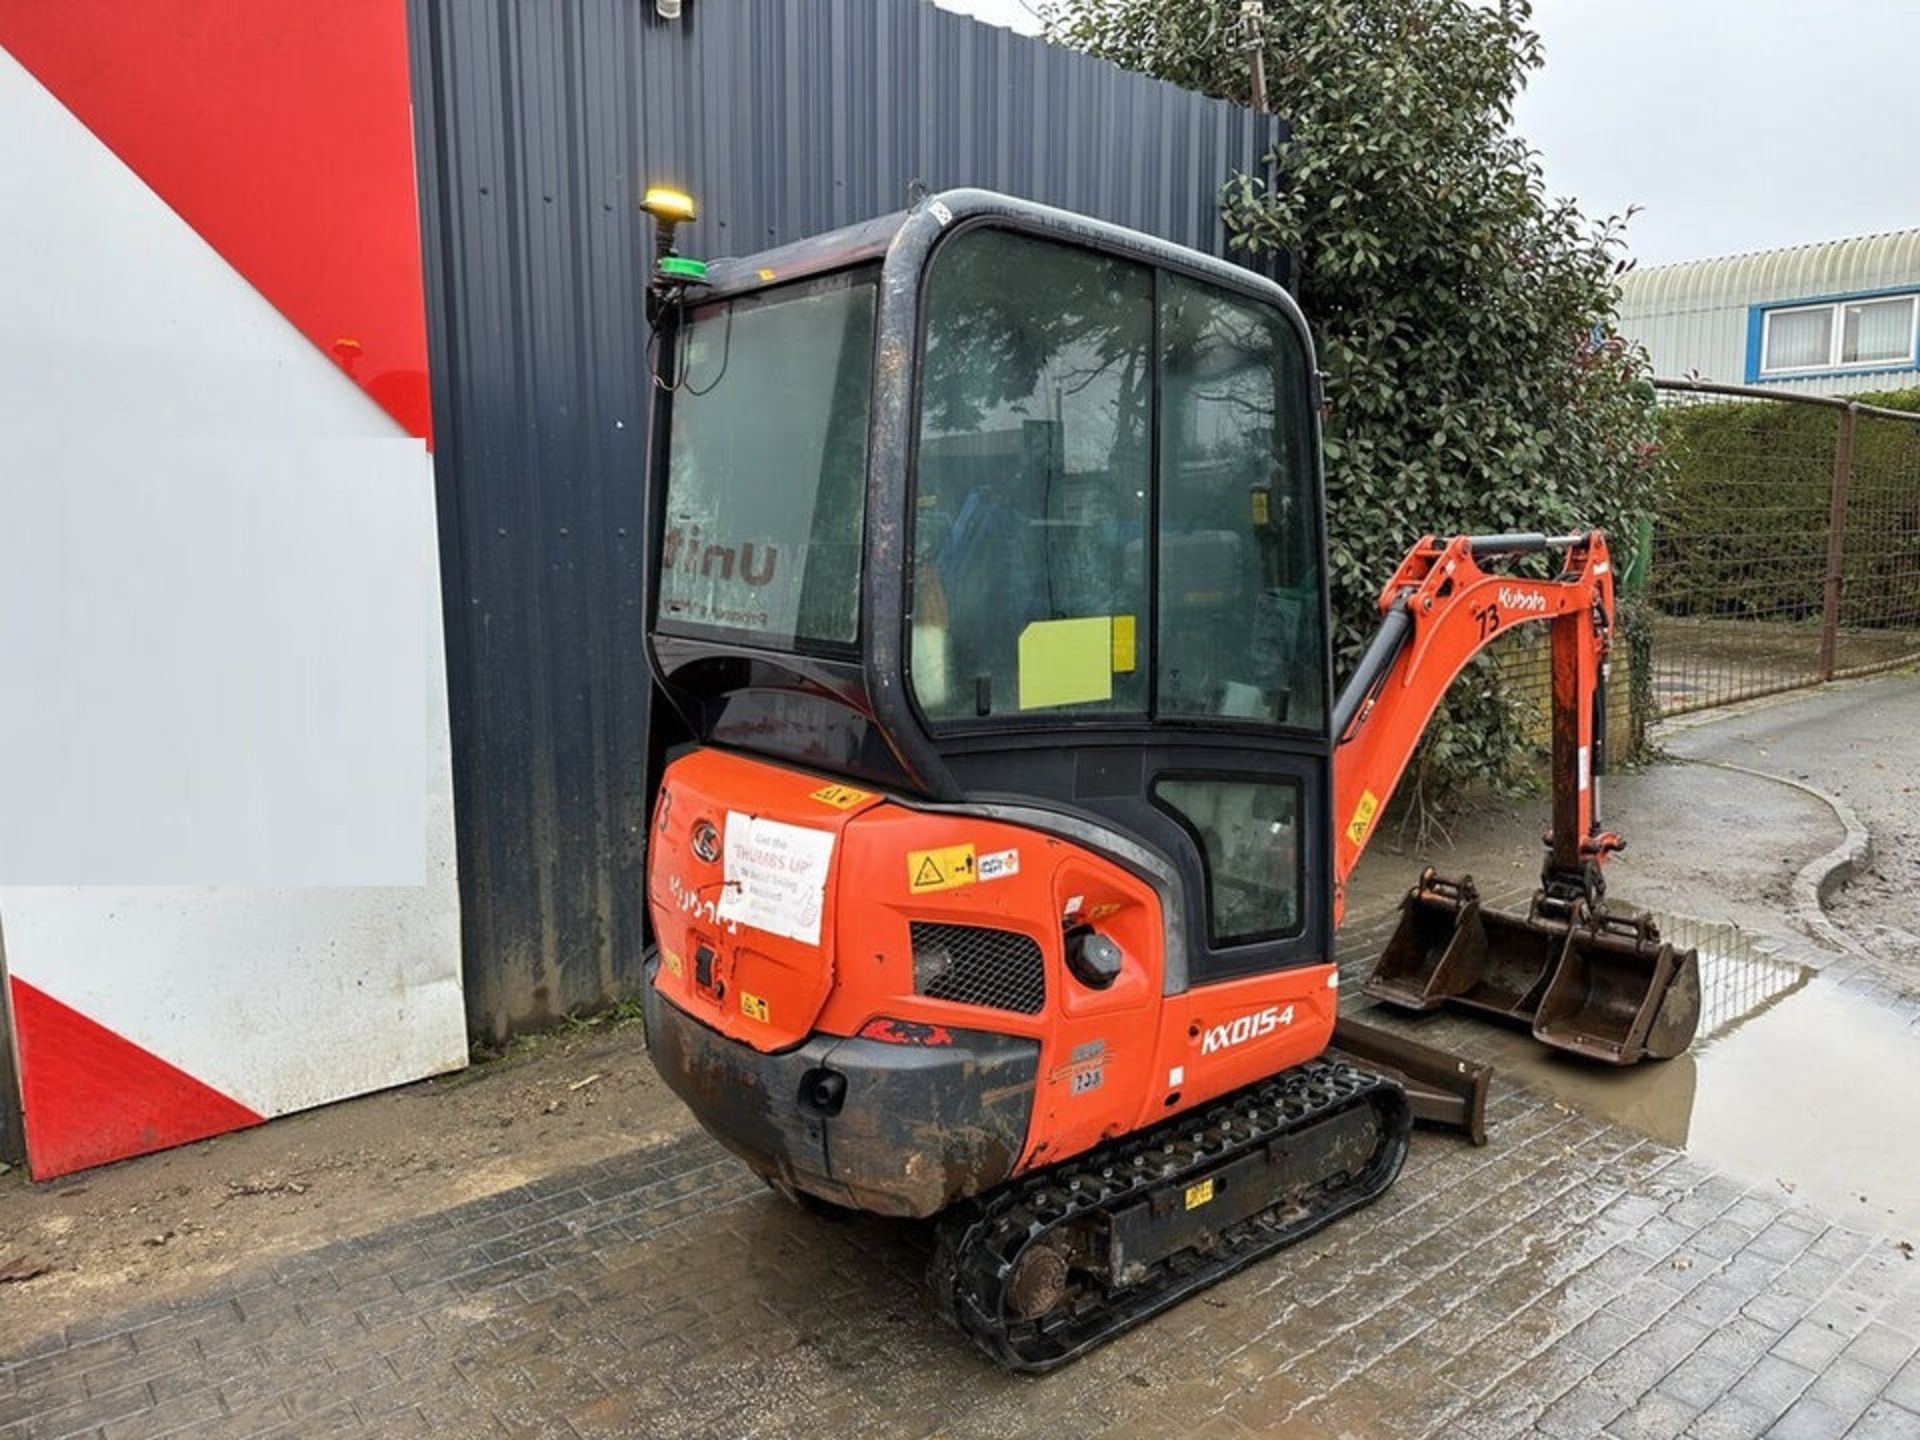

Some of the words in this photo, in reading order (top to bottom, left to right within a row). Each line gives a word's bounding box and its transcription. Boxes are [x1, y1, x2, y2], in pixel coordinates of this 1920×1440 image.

[1498, 587, 1546, 612] Kubota
[1475, 603, 1500, 641] 73
[1201, 1005, 1295, 1056] KX015-4
